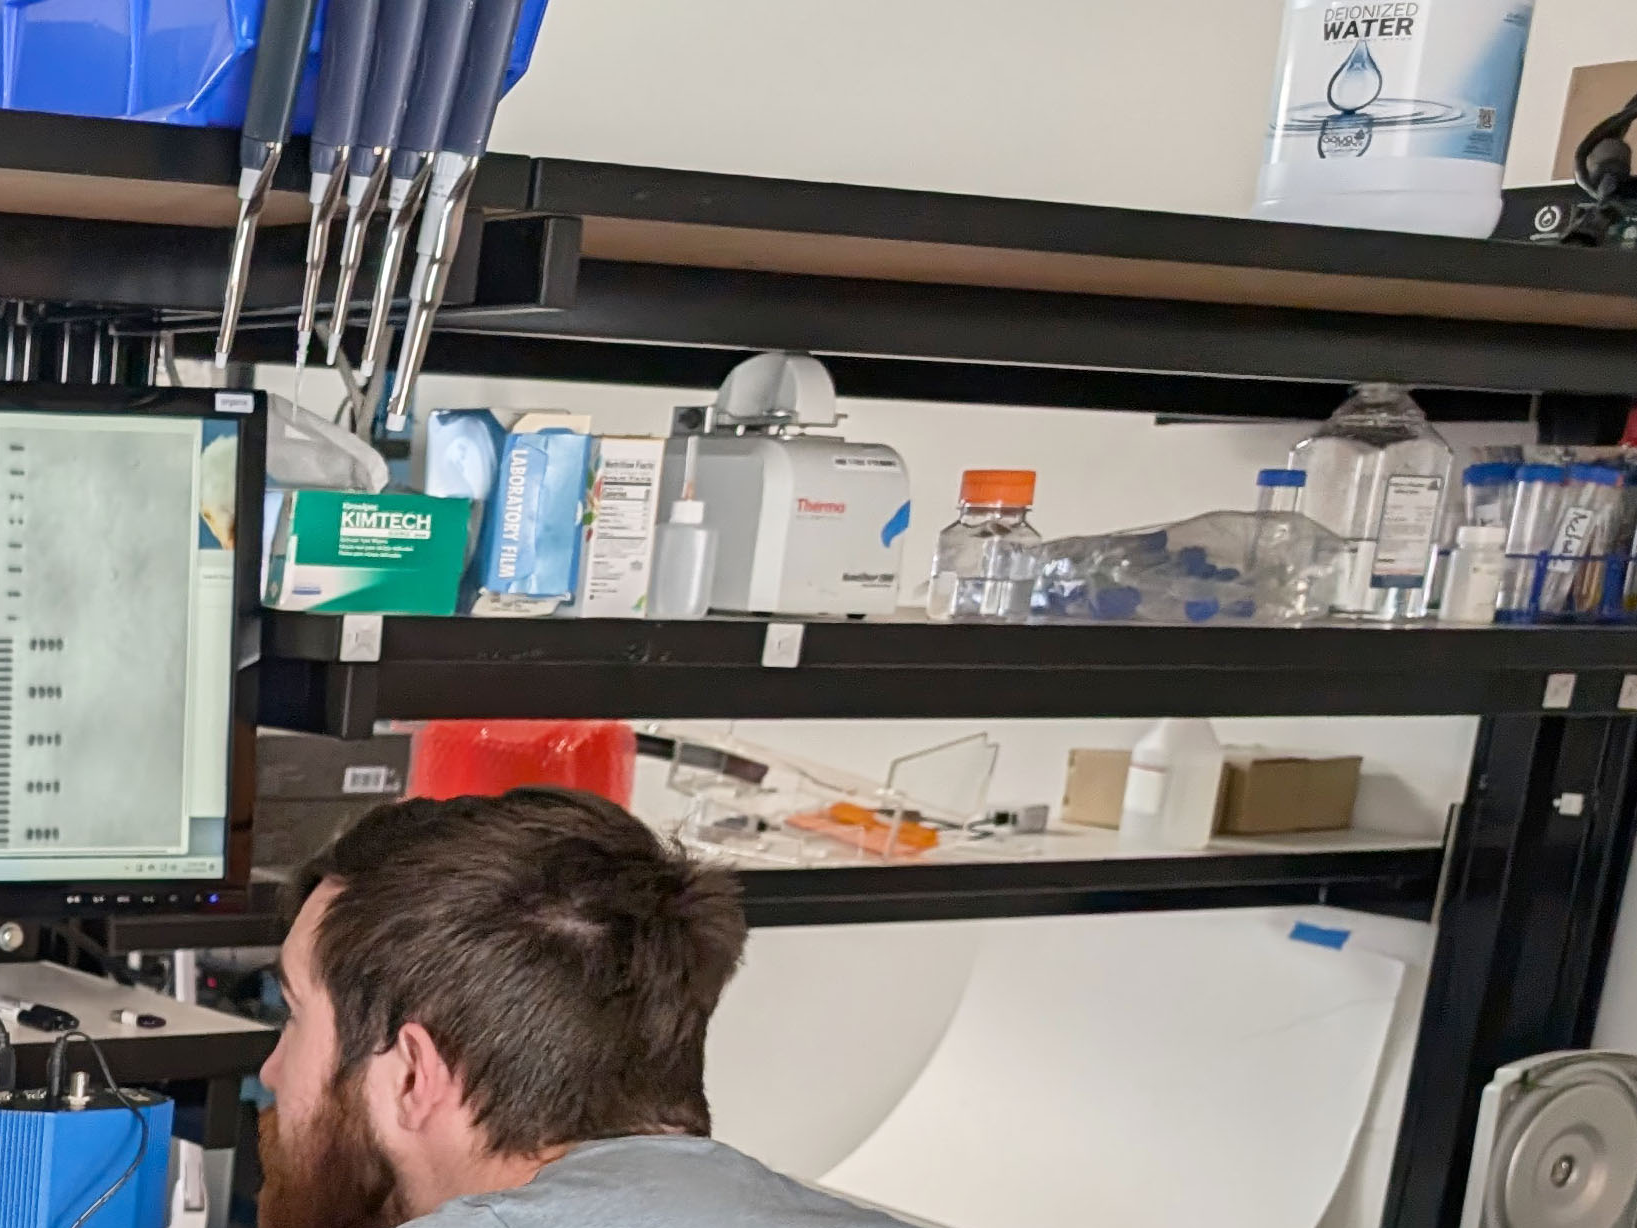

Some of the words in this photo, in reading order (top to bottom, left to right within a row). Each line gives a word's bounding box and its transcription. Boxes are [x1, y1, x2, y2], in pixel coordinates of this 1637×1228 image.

[1324, 2, 1419, 22] DEIONIZED
[1323, 17, 1414, 41] WATER
[502, 448, 529, 542] LABORATORY
[797, 498, 846, 513] Thermo
[340, 511, 432, 530] KIMTECH
[498, 545, 518, 579] FILM
